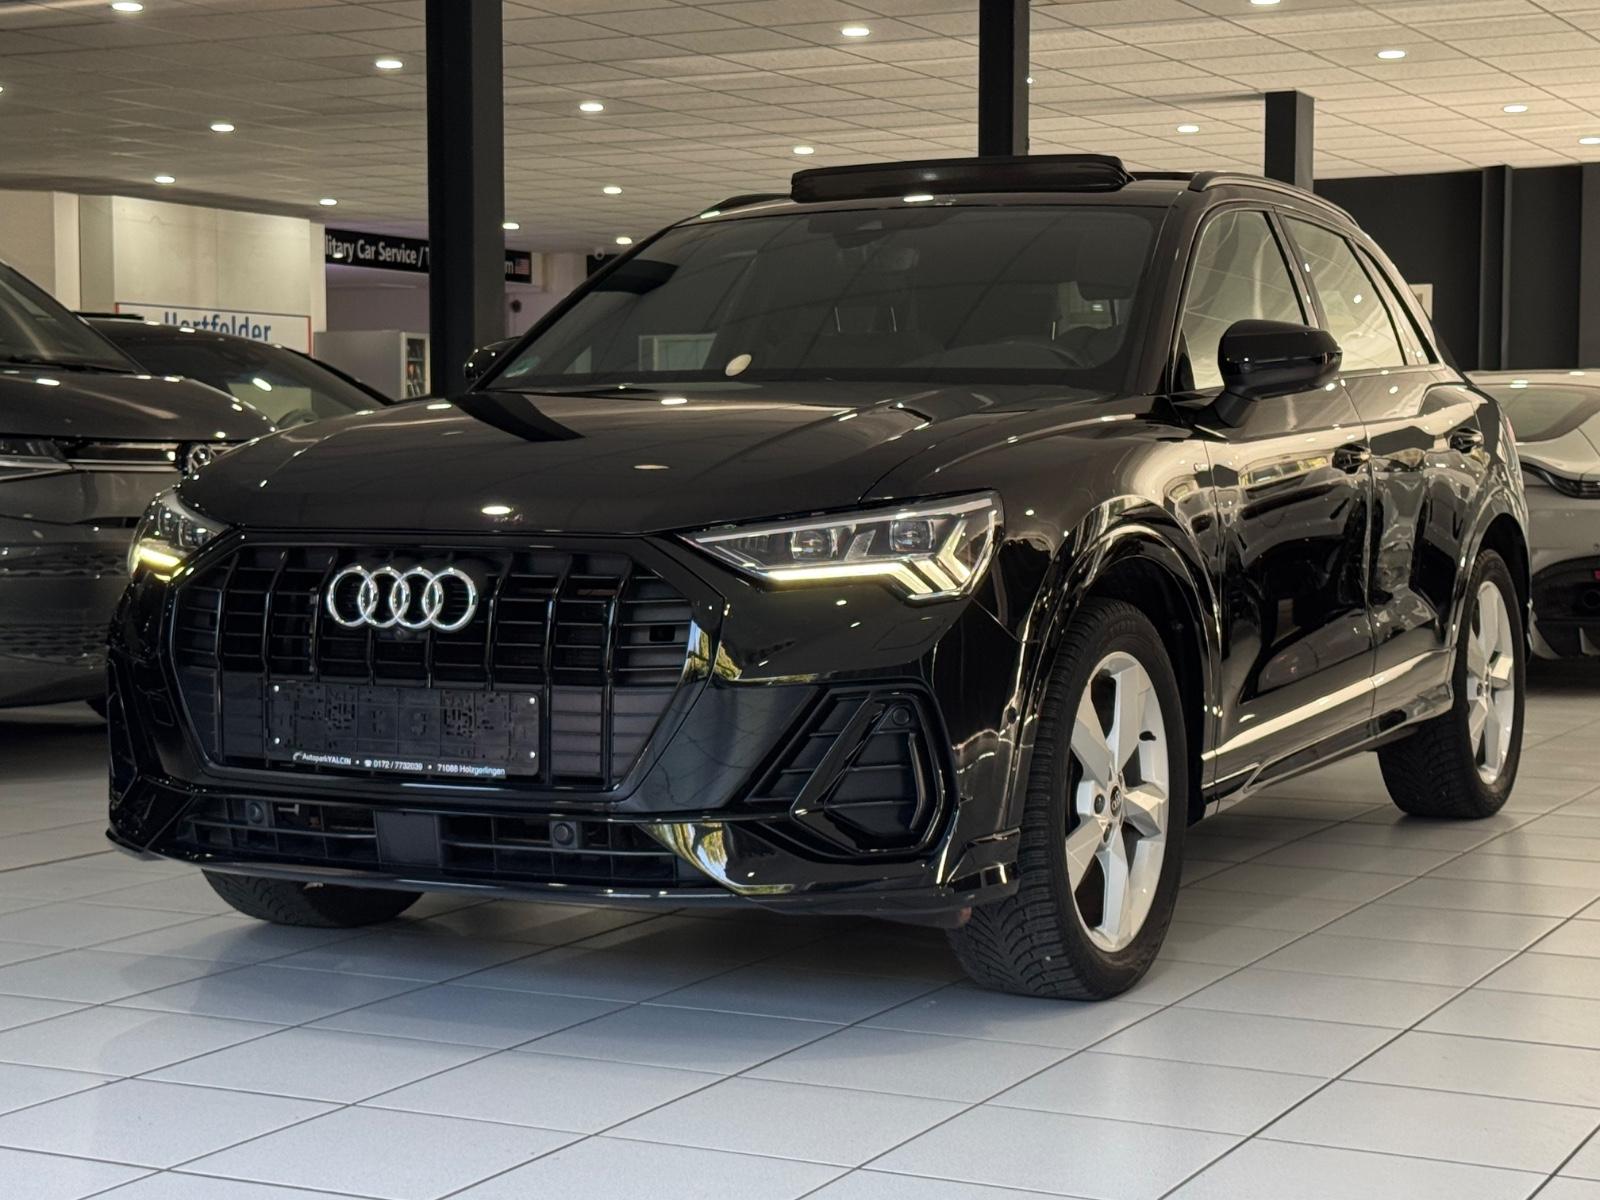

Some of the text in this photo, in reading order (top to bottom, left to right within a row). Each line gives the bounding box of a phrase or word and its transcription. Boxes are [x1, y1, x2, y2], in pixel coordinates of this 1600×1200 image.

[325, 234, 355, 263] litary
[356, 239, 377, 260] Car
[378, 241, 417, 264] Service
[373, 759, 390, 769] 0172
